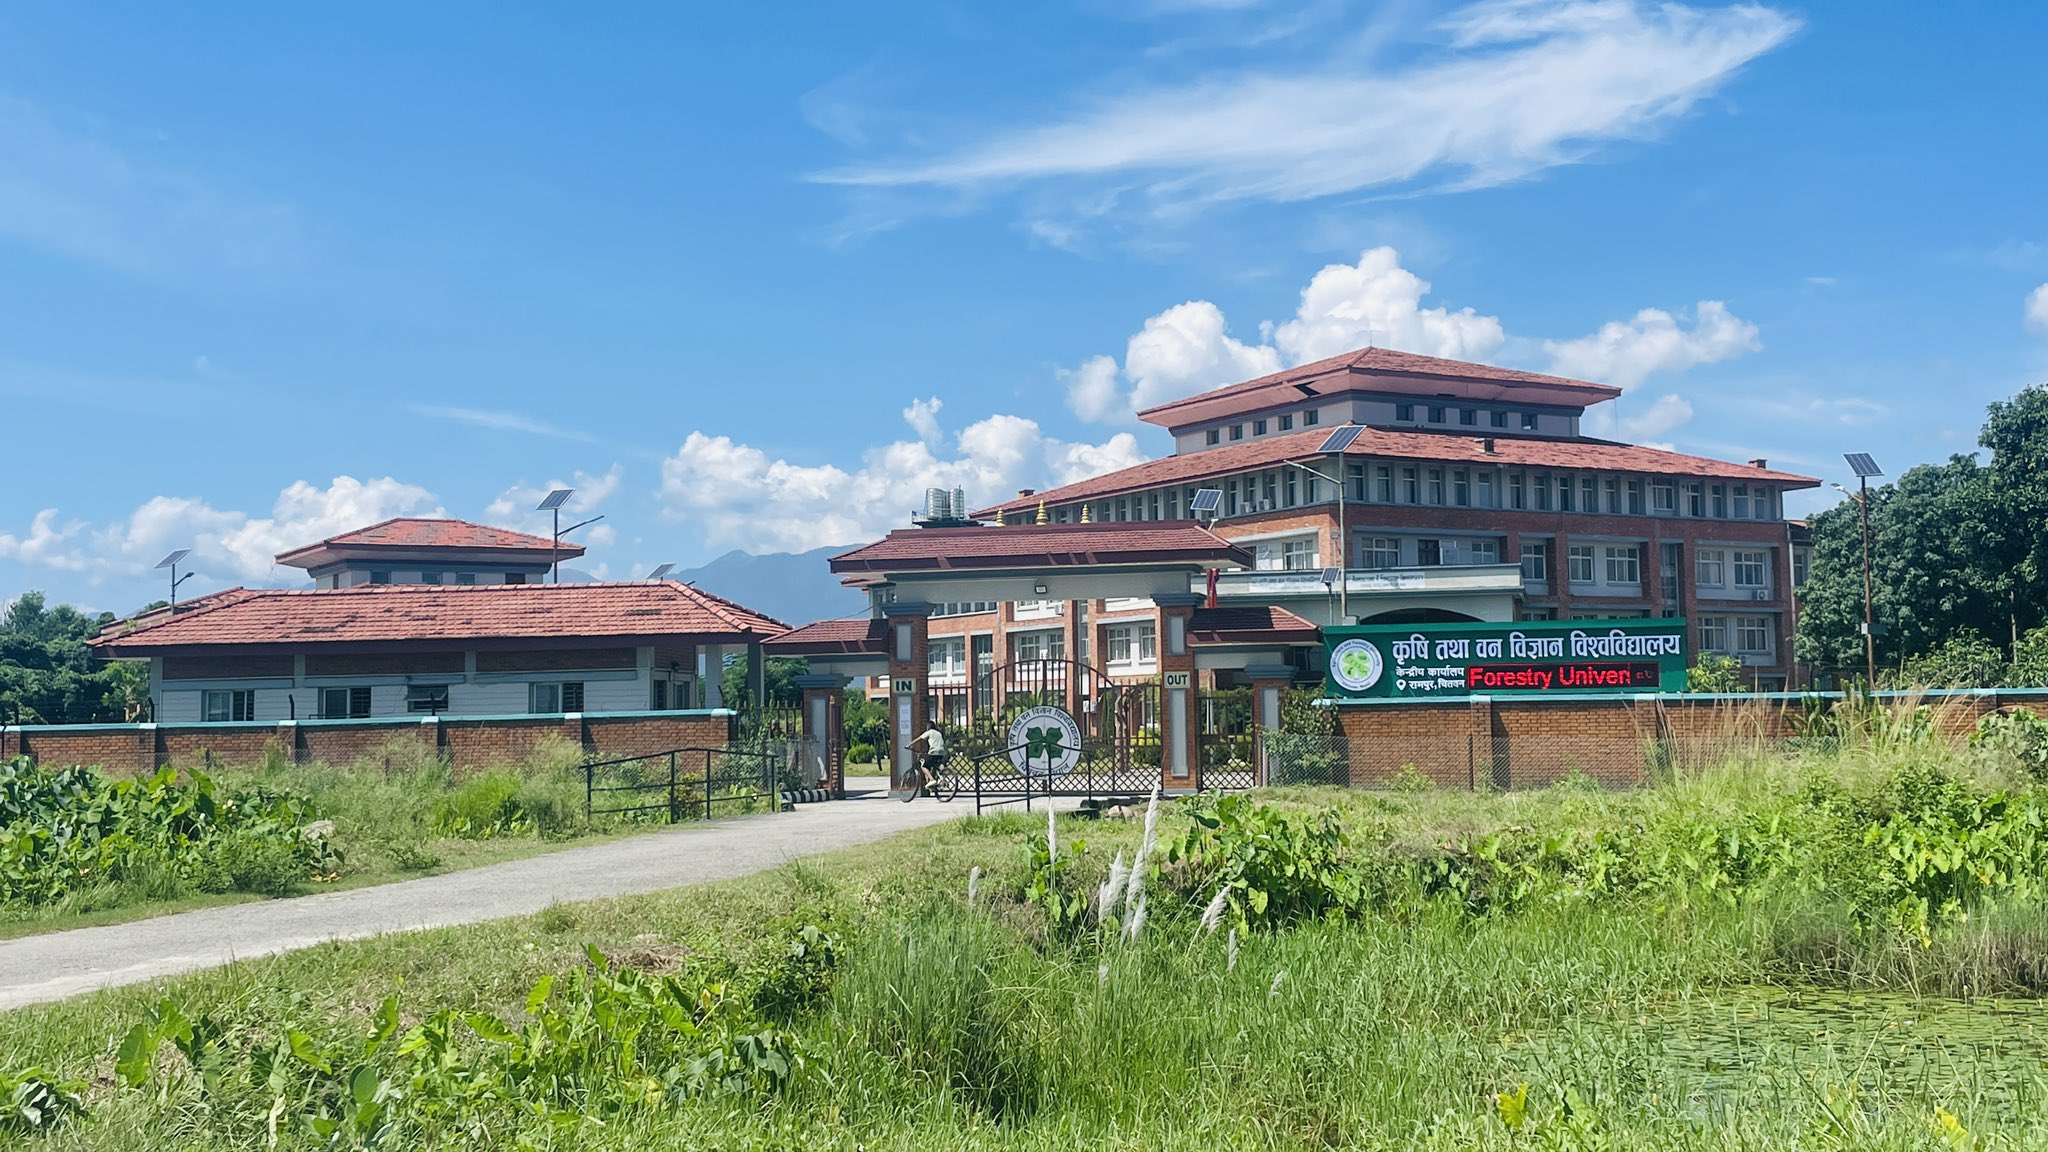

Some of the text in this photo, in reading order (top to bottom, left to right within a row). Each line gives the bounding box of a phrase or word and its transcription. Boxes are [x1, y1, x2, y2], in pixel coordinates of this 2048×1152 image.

[1392, 629, 1681, 665] कृषि तथा वन विज्ञान विश्वविद्यालय
[896, 680, 912, 691] IN
[1167, 674, 1188, 685] OUT
[1470, 667, 1552, 690] Forestry
